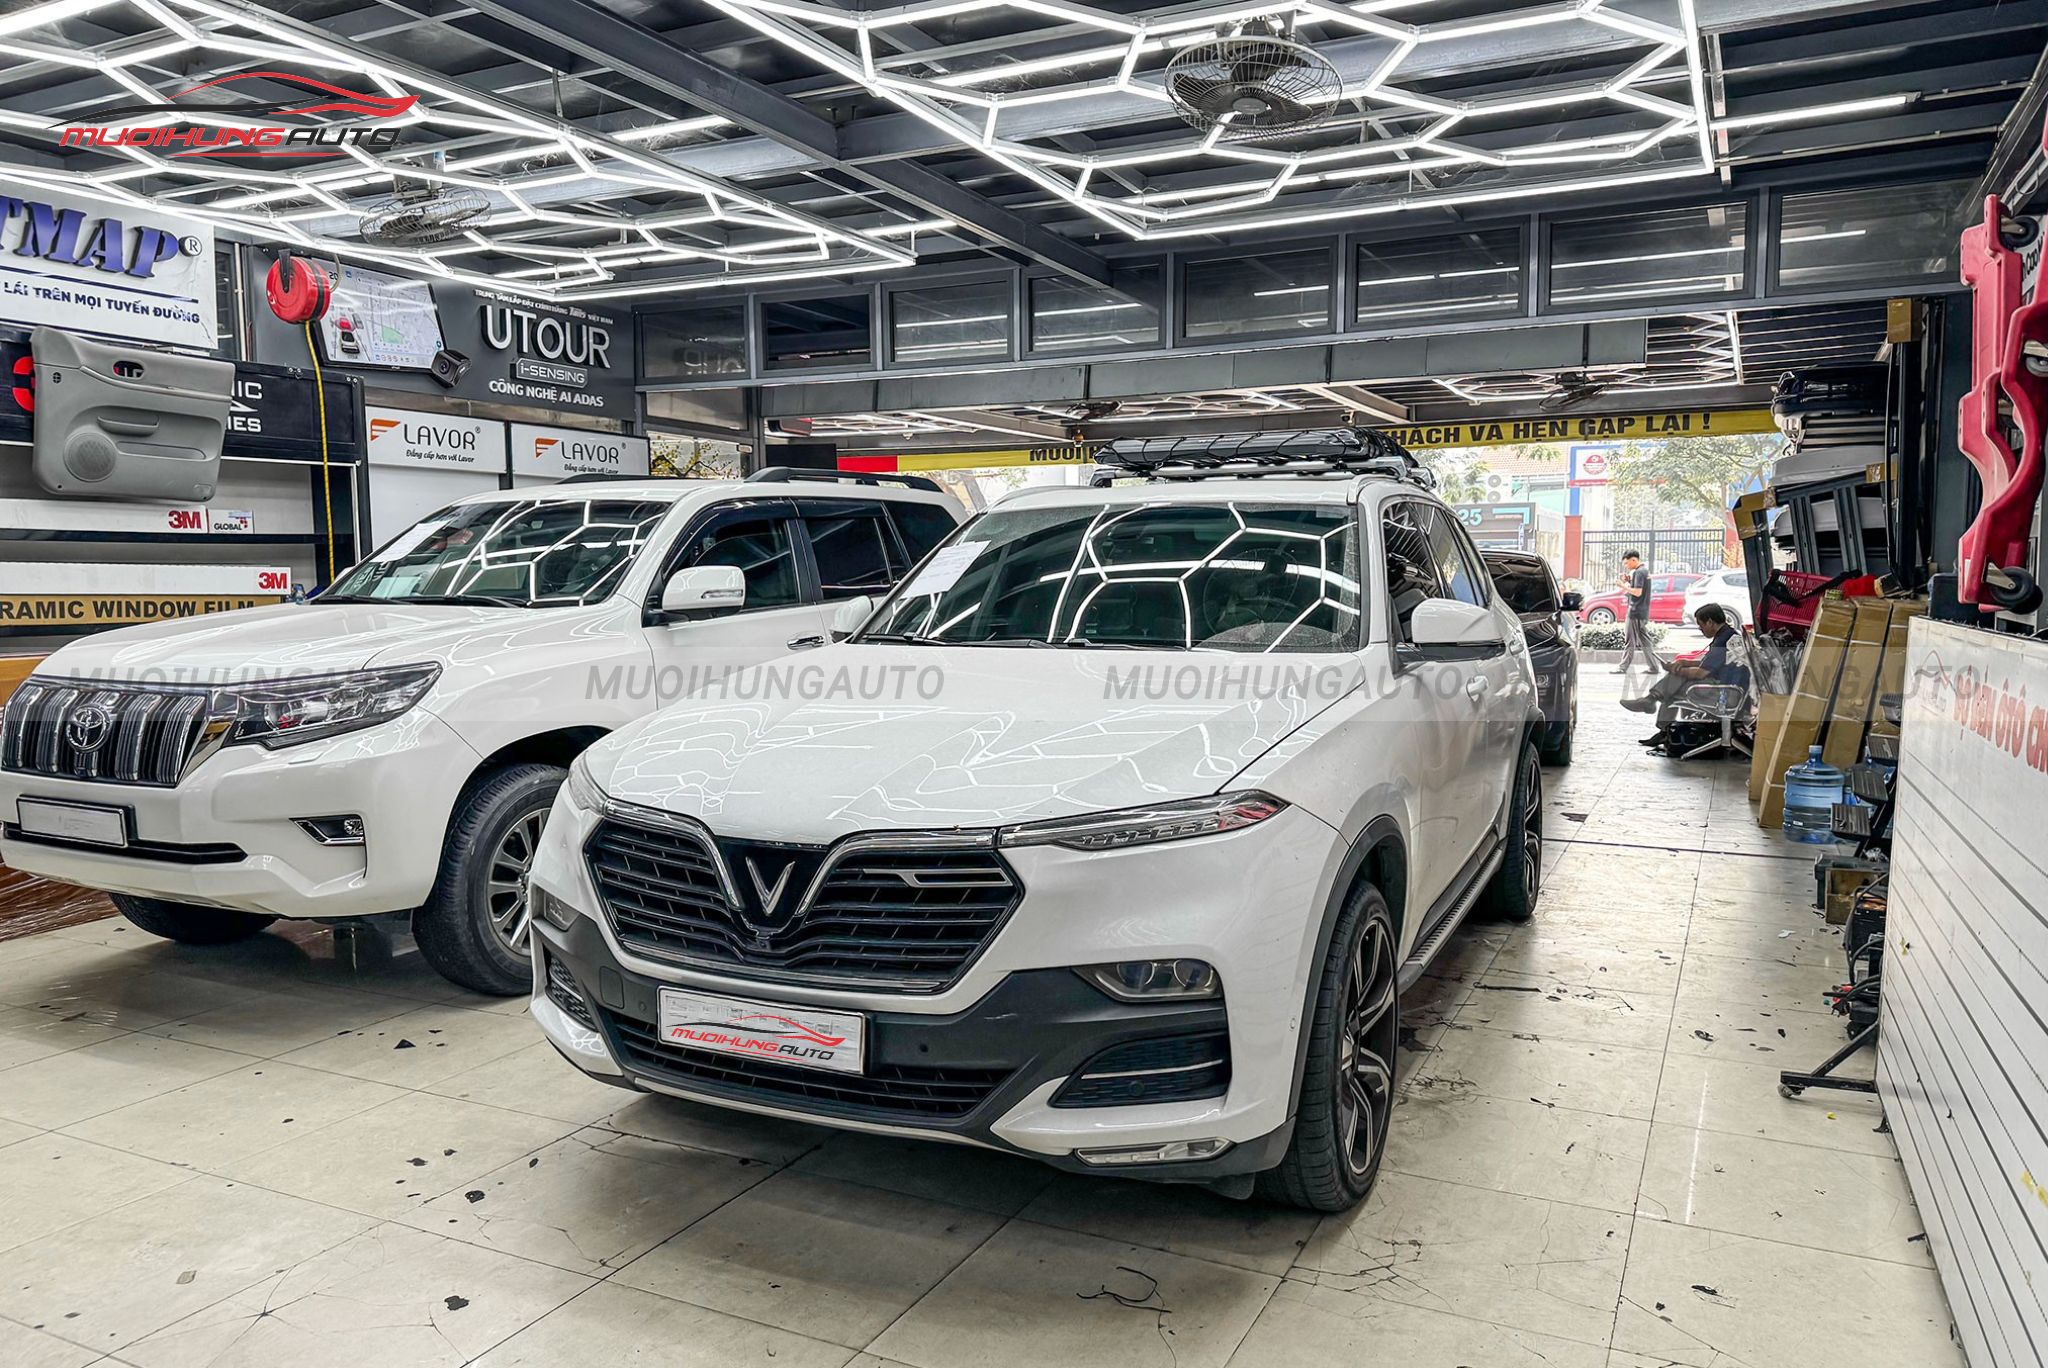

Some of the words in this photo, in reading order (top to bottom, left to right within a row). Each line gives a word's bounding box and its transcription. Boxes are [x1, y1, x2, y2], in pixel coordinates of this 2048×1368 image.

[4, 281, 28, 296] LÁI
[33, 286, 71, 303] TRÊN
[75, 292, 101, 310] MỌI
[105, 298, 150, 316] TUYẾN
[484, 304, 611, 368] UTOUR
[520, 363, 586, 384] i-SENSING
[231, 380, 262, 399] IC
[489, 378, 524, 396] CÔNG
[525, 386, 557, 403] NGHỆ
[559, 391, 572, 403] AI
[573, 393, 604, 407] ADAS
[404, 424, 476, 450] LAVOR
[1513, 420, 1568, 442] HẸN
[1645, 414, 1690, 435] LẠI
[561, 441, 619, 464] LAVOR
[168, 510, 202, 529] 3M
[214, 522, 243, 531] GLOBAL
[258, 572, 288, 590] 3M
[0, 601, 84, 619] RAMIC
[92, 601, 196, 617] WINDOW
